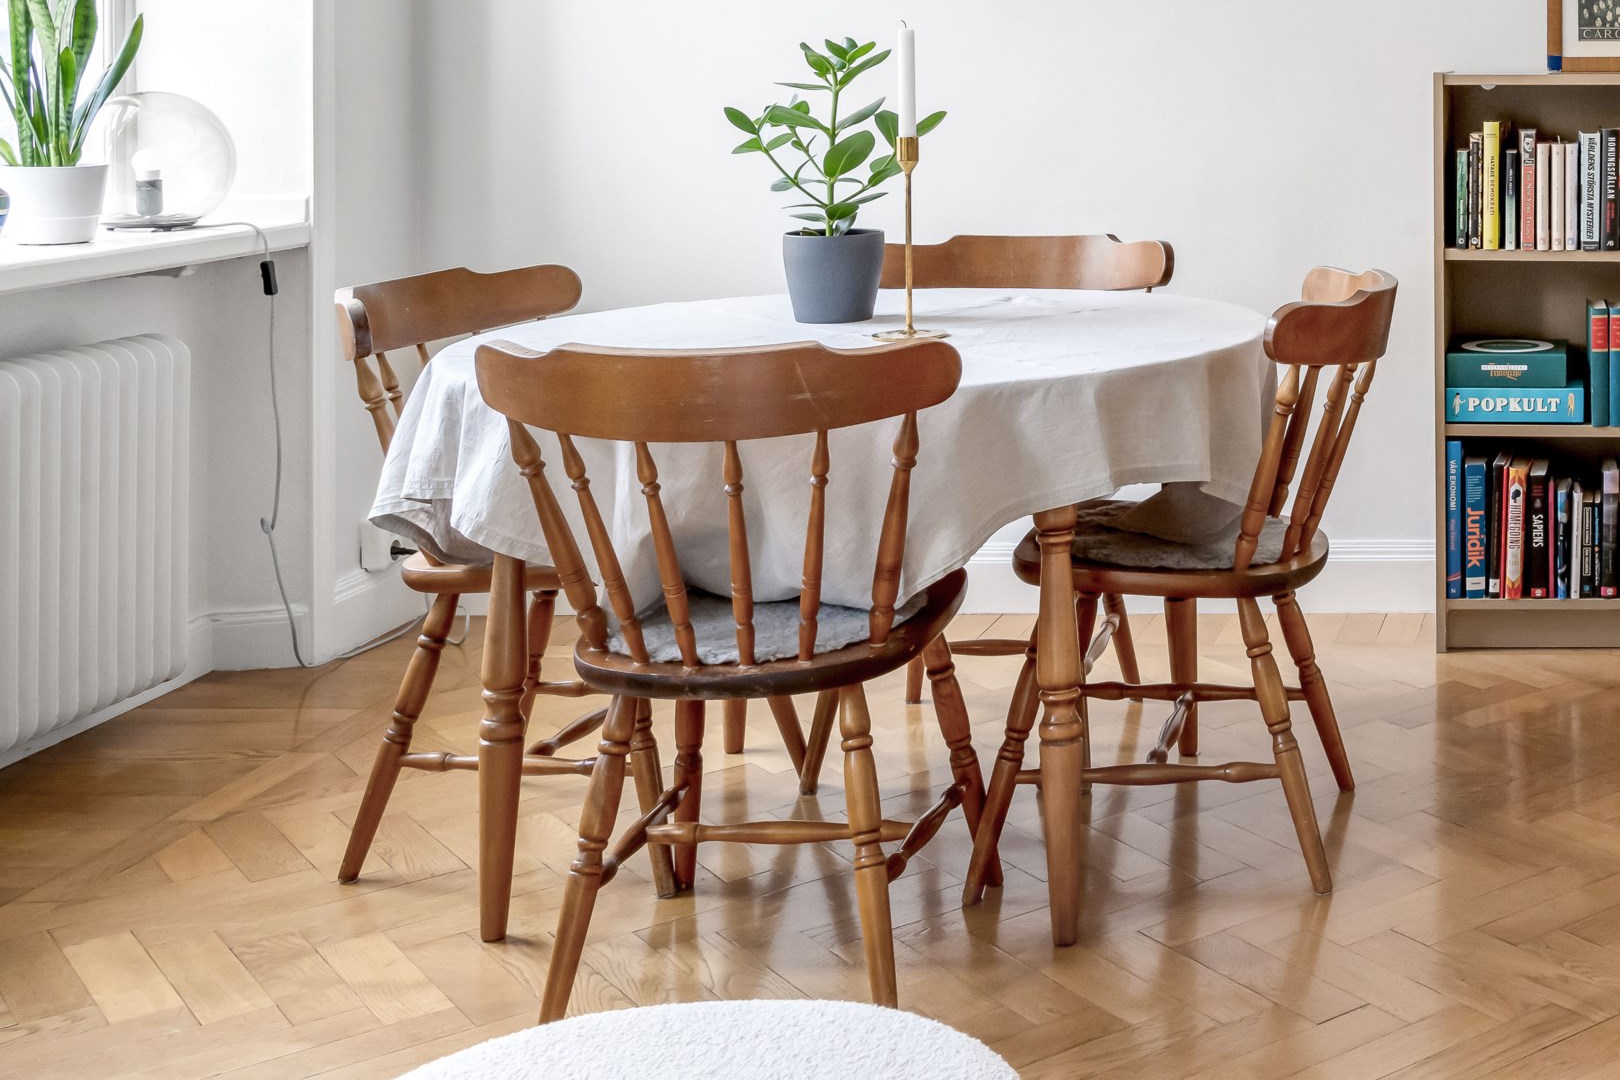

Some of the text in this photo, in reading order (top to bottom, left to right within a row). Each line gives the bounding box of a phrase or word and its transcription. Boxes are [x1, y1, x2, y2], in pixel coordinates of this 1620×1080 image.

[1587, 137, 1597, 171] VÄRLDENS
[1607, 137, 1617, 199] HONUNGSFÄLLAN
[1587, 172, 1597, 201] STÖRSTA
[1586, 202, 1595, 240] MYSTERIER
[1468, 398, 1560, 412] POPKULT
[1467, 507, 1485, 568] Juridik
[1509, 505, 1522, 550] HOMEGOING
[1532, 514, 1544, 548] SAPIENS
